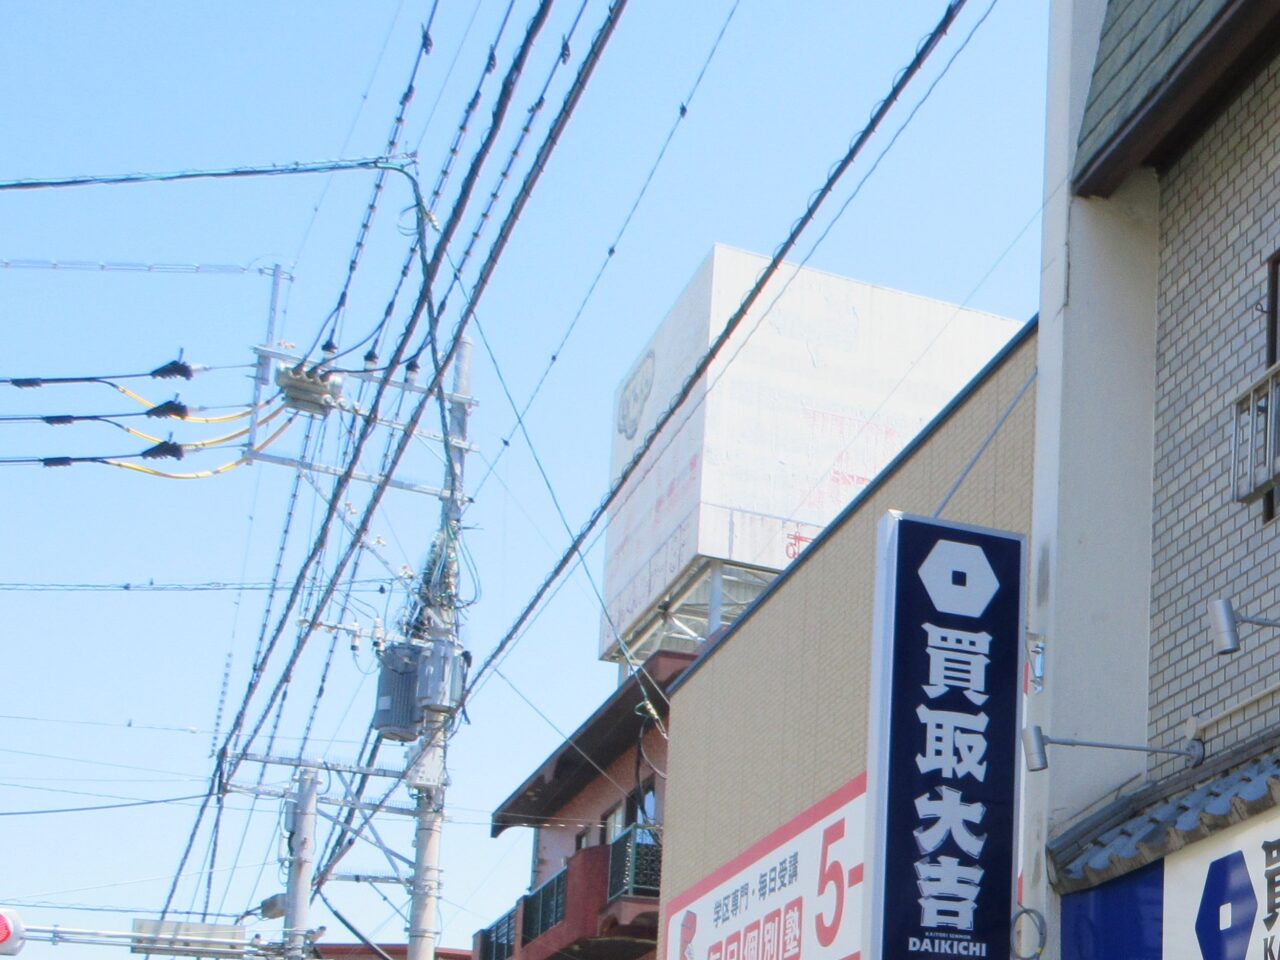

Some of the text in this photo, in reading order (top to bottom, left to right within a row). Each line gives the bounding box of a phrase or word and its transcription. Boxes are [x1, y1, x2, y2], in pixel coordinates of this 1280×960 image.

[913, 622, 992, 932] 買取大吉
[908, 937, 987, 957] DAIKICHI
